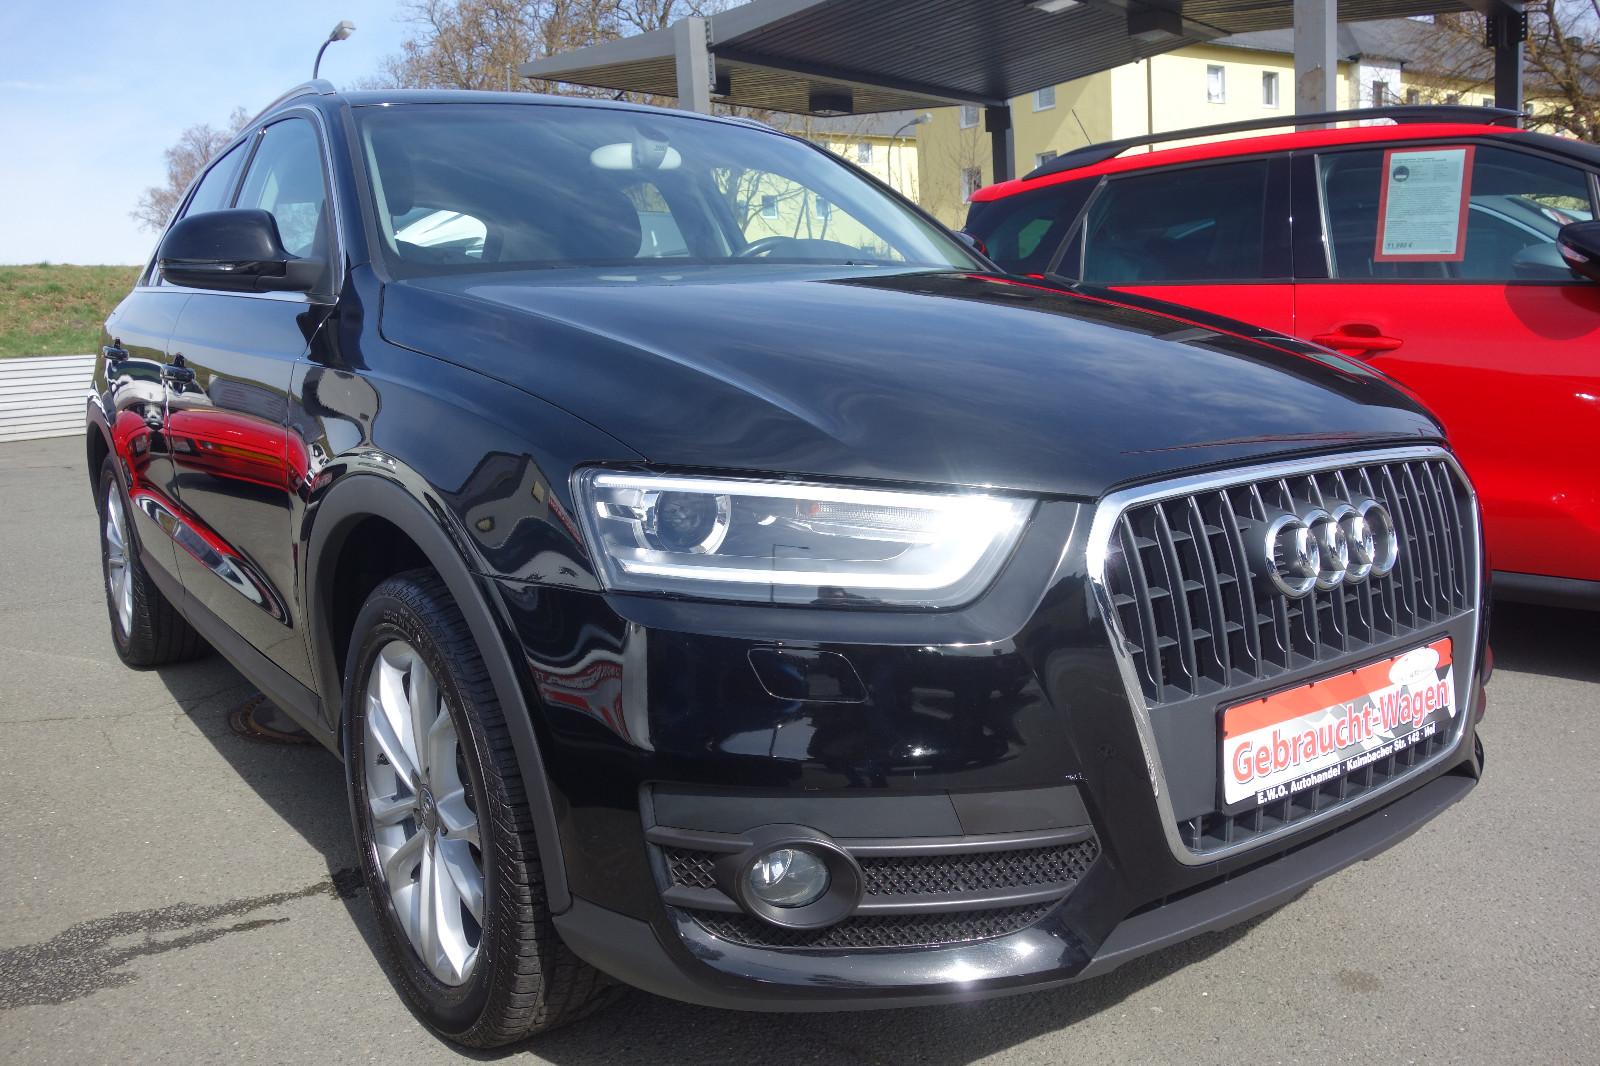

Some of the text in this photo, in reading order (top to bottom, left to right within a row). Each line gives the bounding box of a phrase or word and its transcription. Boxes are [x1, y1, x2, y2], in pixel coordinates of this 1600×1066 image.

[1232, 678, 1450, 784] Gebraucht-Wagen
[1257, 785, 1289, 805] E.W.O.
[1290, 764, 1341, 793] Autohandel
[1394, 738, 1407, 752] Str.
